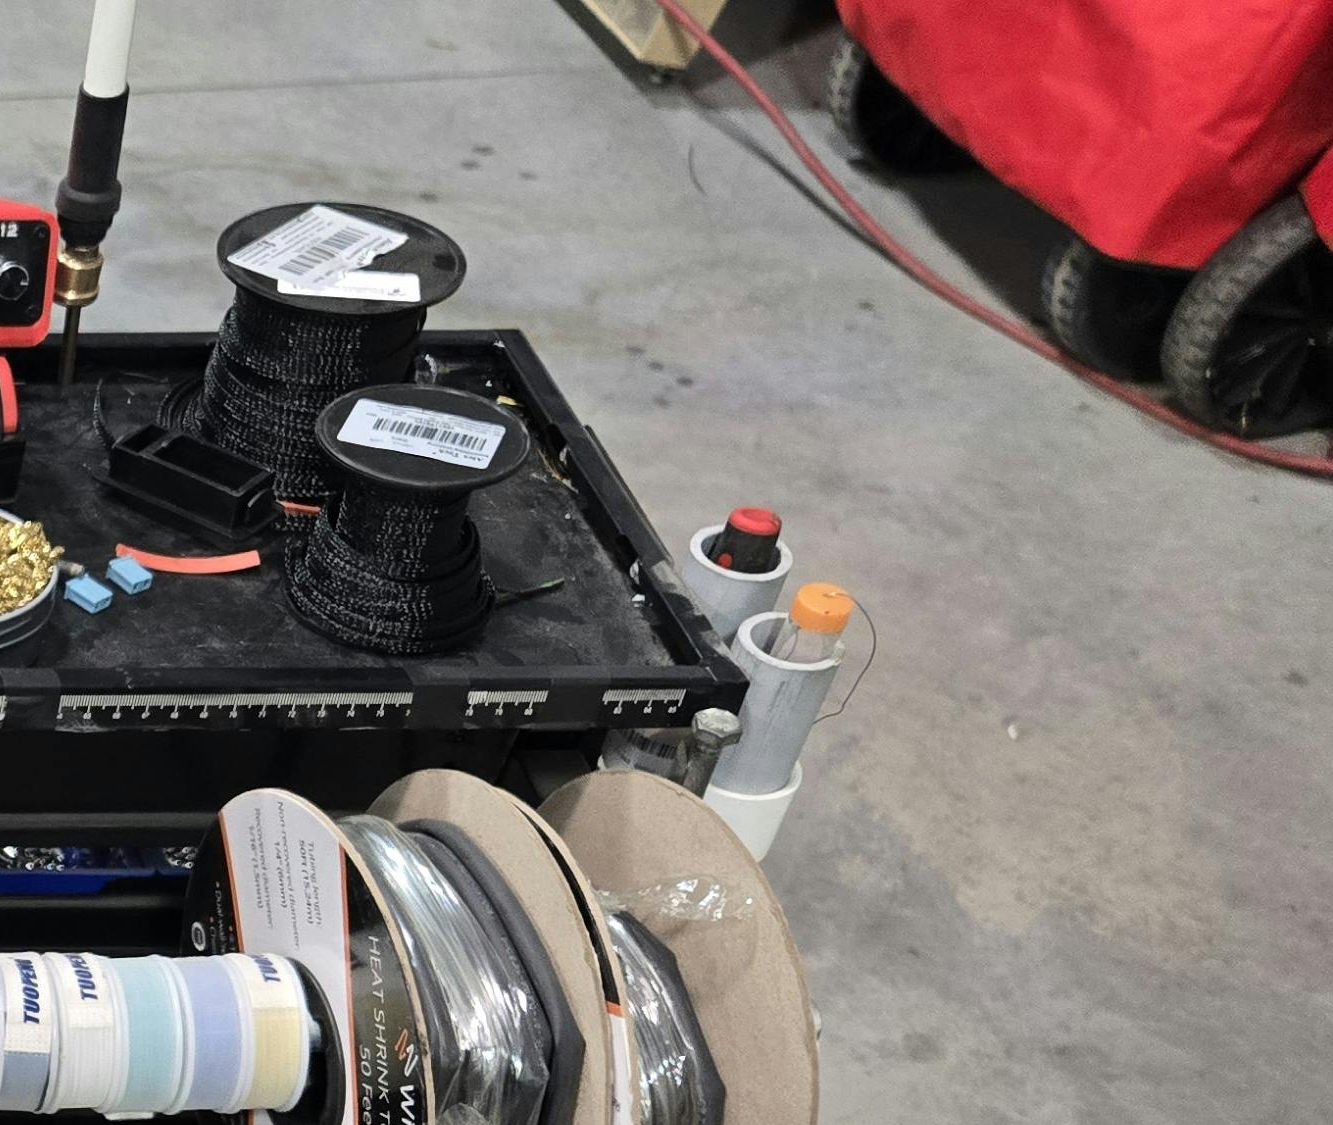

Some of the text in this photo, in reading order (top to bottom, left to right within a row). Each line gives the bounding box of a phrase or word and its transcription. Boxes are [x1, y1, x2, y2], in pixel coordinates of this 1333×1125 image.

[254, 808, 269, 871] Recovered
[277, 800, 296, 893] Non-recovered
[307, 841, 320, 883] Tubing
[366, 935, 385, 1004] HEAT
[359, 1045, 374, 1082] 50
[372, 1008, 392, 1105] SHRINK
